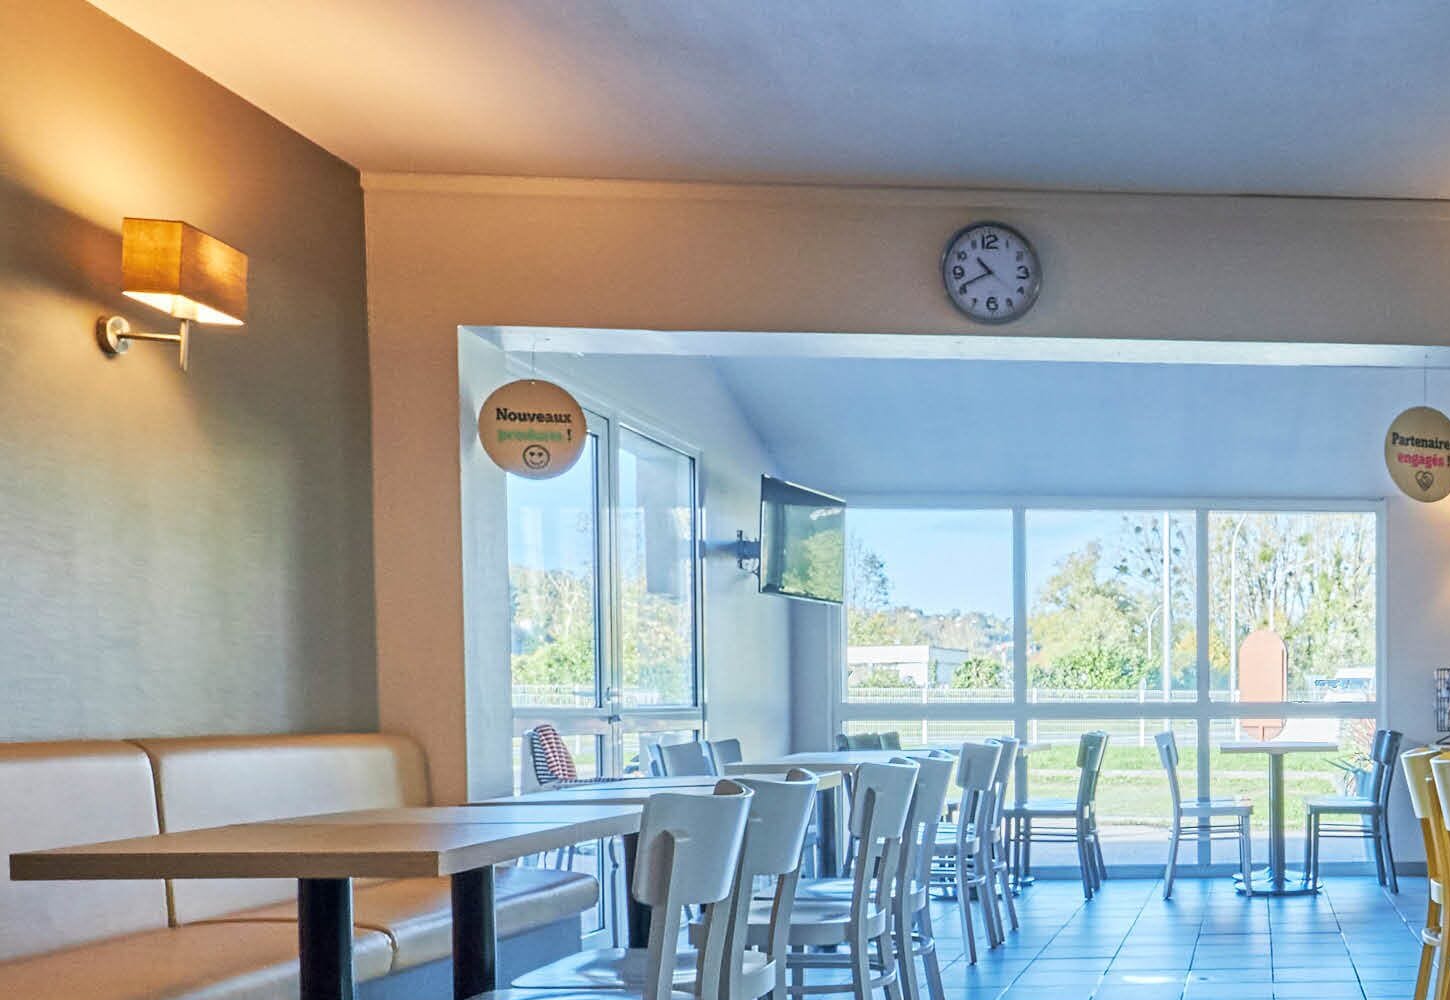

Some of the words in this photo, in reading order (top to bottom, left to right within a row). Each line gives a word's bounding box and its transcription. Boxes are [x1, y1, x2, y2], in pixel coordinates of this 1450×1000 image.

[981, 234, 999, 250] 12
[952, 265, 965, 280] 9
[1016, 265, 1029, 280] 3
[986, 296, 998, 311] 6
[495, 407, 572, 424] Nouveaux
